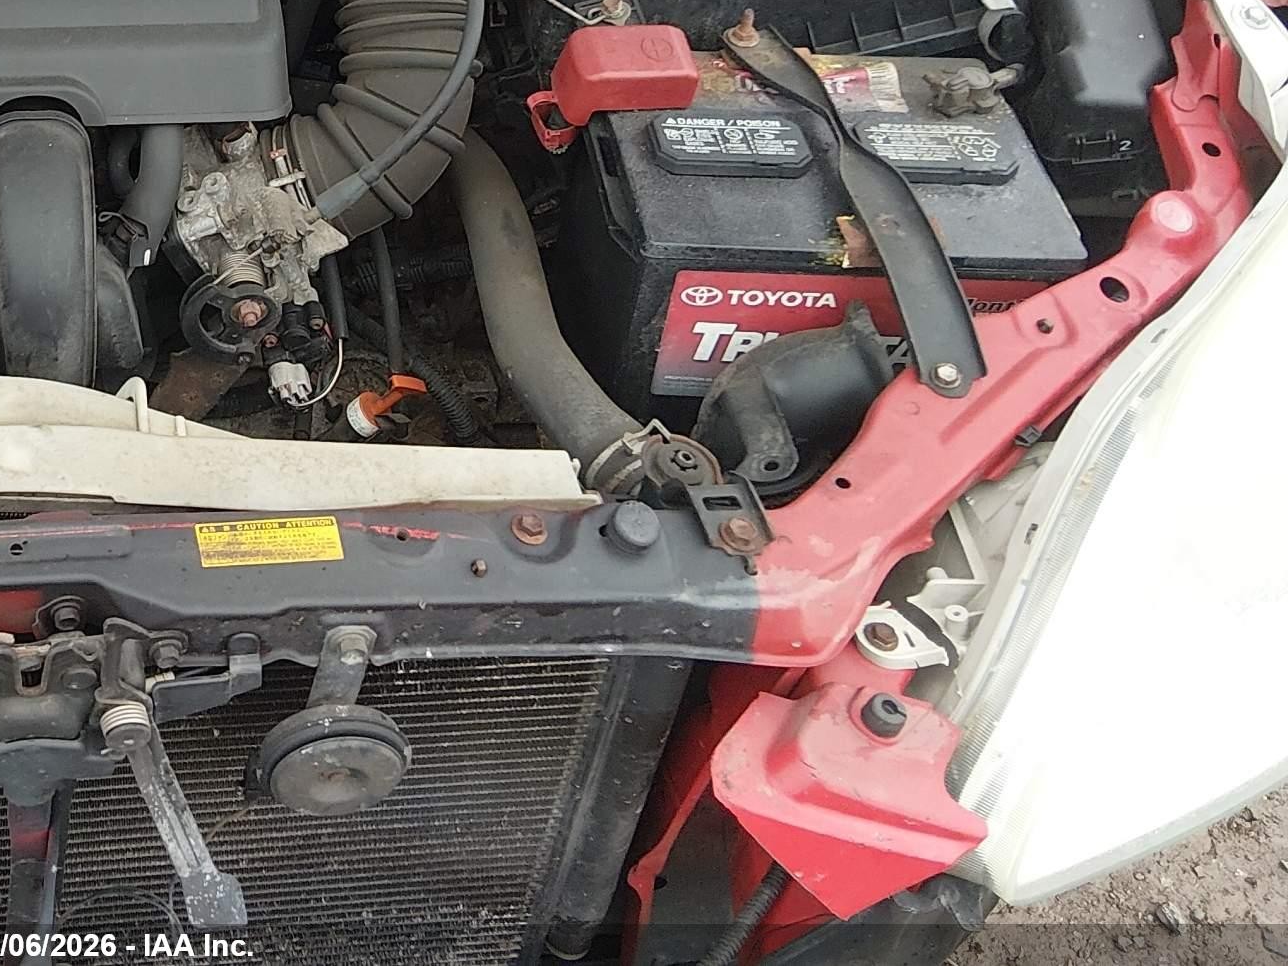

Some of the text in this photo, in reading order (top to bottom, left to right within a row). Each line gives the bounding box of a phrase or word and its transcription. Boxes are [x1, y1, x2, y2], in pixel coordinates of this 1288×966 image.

[678, 118, 725, 126] DANGER
[1119, 140, 1132, 151] 2
[727, 289, 837, 309] TOYOTA
[237, 522, 280, 531] CAUTION
[286, 519, 332, 527] ATTENTION
